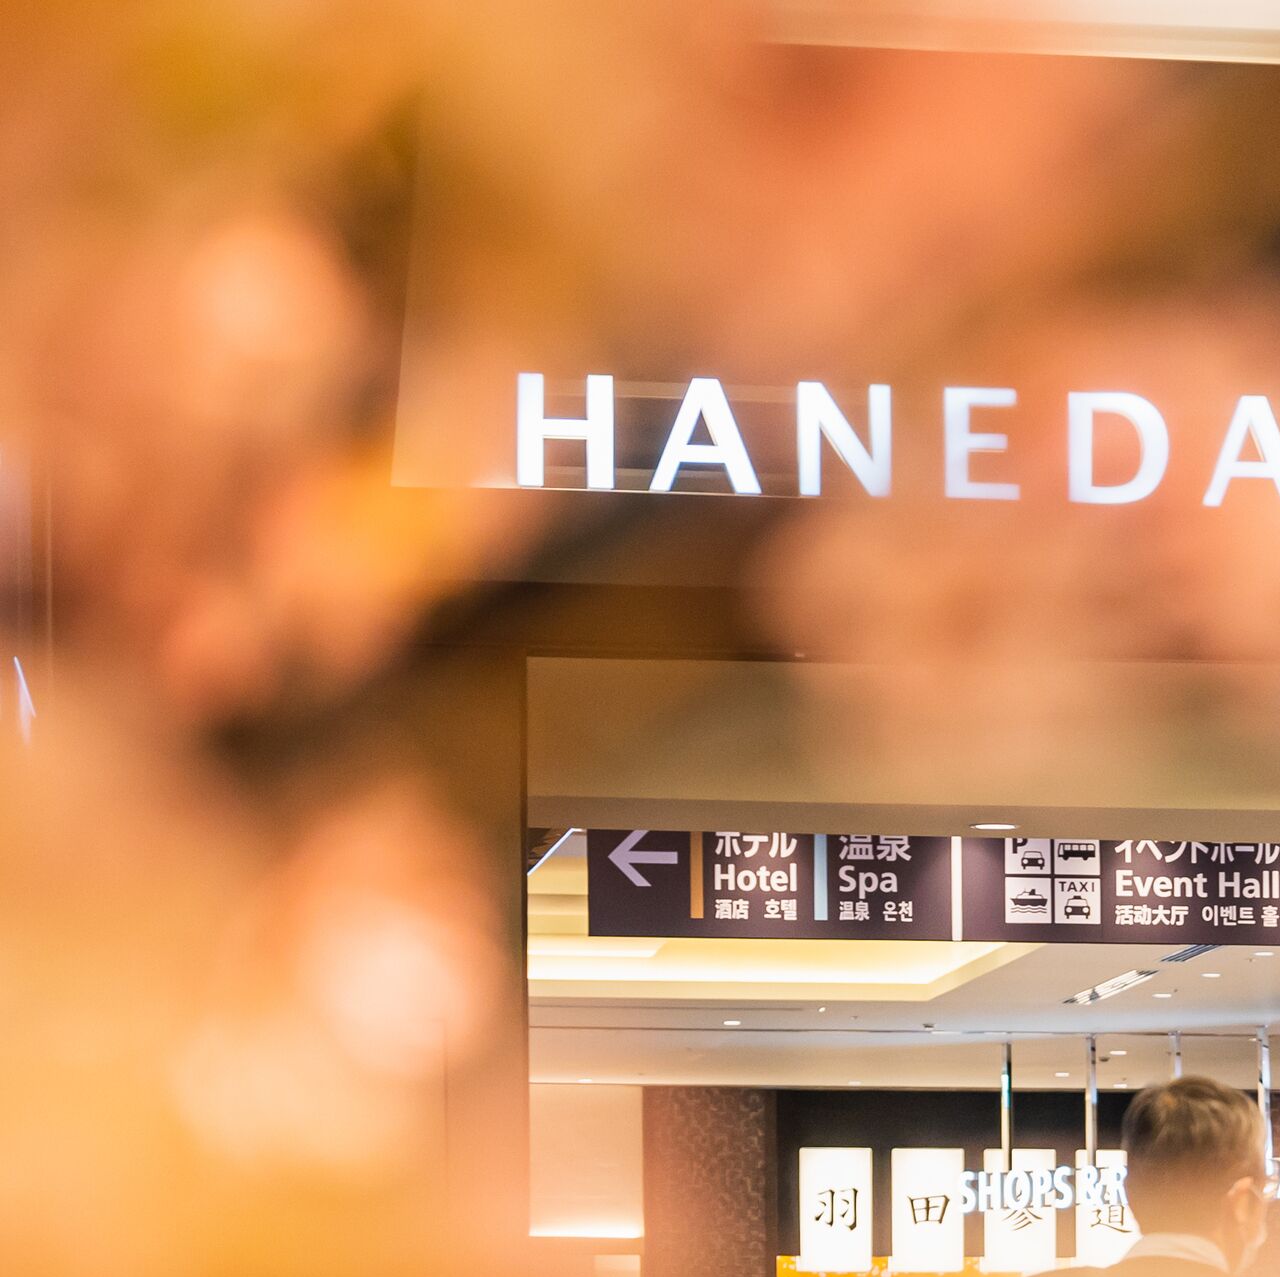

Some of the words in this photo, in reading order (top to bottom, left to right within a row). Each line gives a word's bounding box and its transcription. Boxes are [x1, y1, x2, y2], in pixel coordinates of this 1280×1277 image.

[838, 835, 912, 861] 温泉
[714, 863, 798, 892] Hotel
[838, 865, 899, 899] Spa
[1058, 881, 1095, 893] TAXI
[1115, 869, 1208, 898] Event
[1218, 870, 1280, 899] Hall
[714, 898, 750, 920] 酒店
[763, 899, 798, 921] 호텔
[838, 901, 871, 921] 温泉
[882, 900, 913, 922] 온천
[1114, 904, 1189, 926] 活动大厅
[1201, 904, 1256, 927] 이벤트
[1260, 904, 1280, 928] 홀
[960, 1165, 1073, 1214] SHOPS
